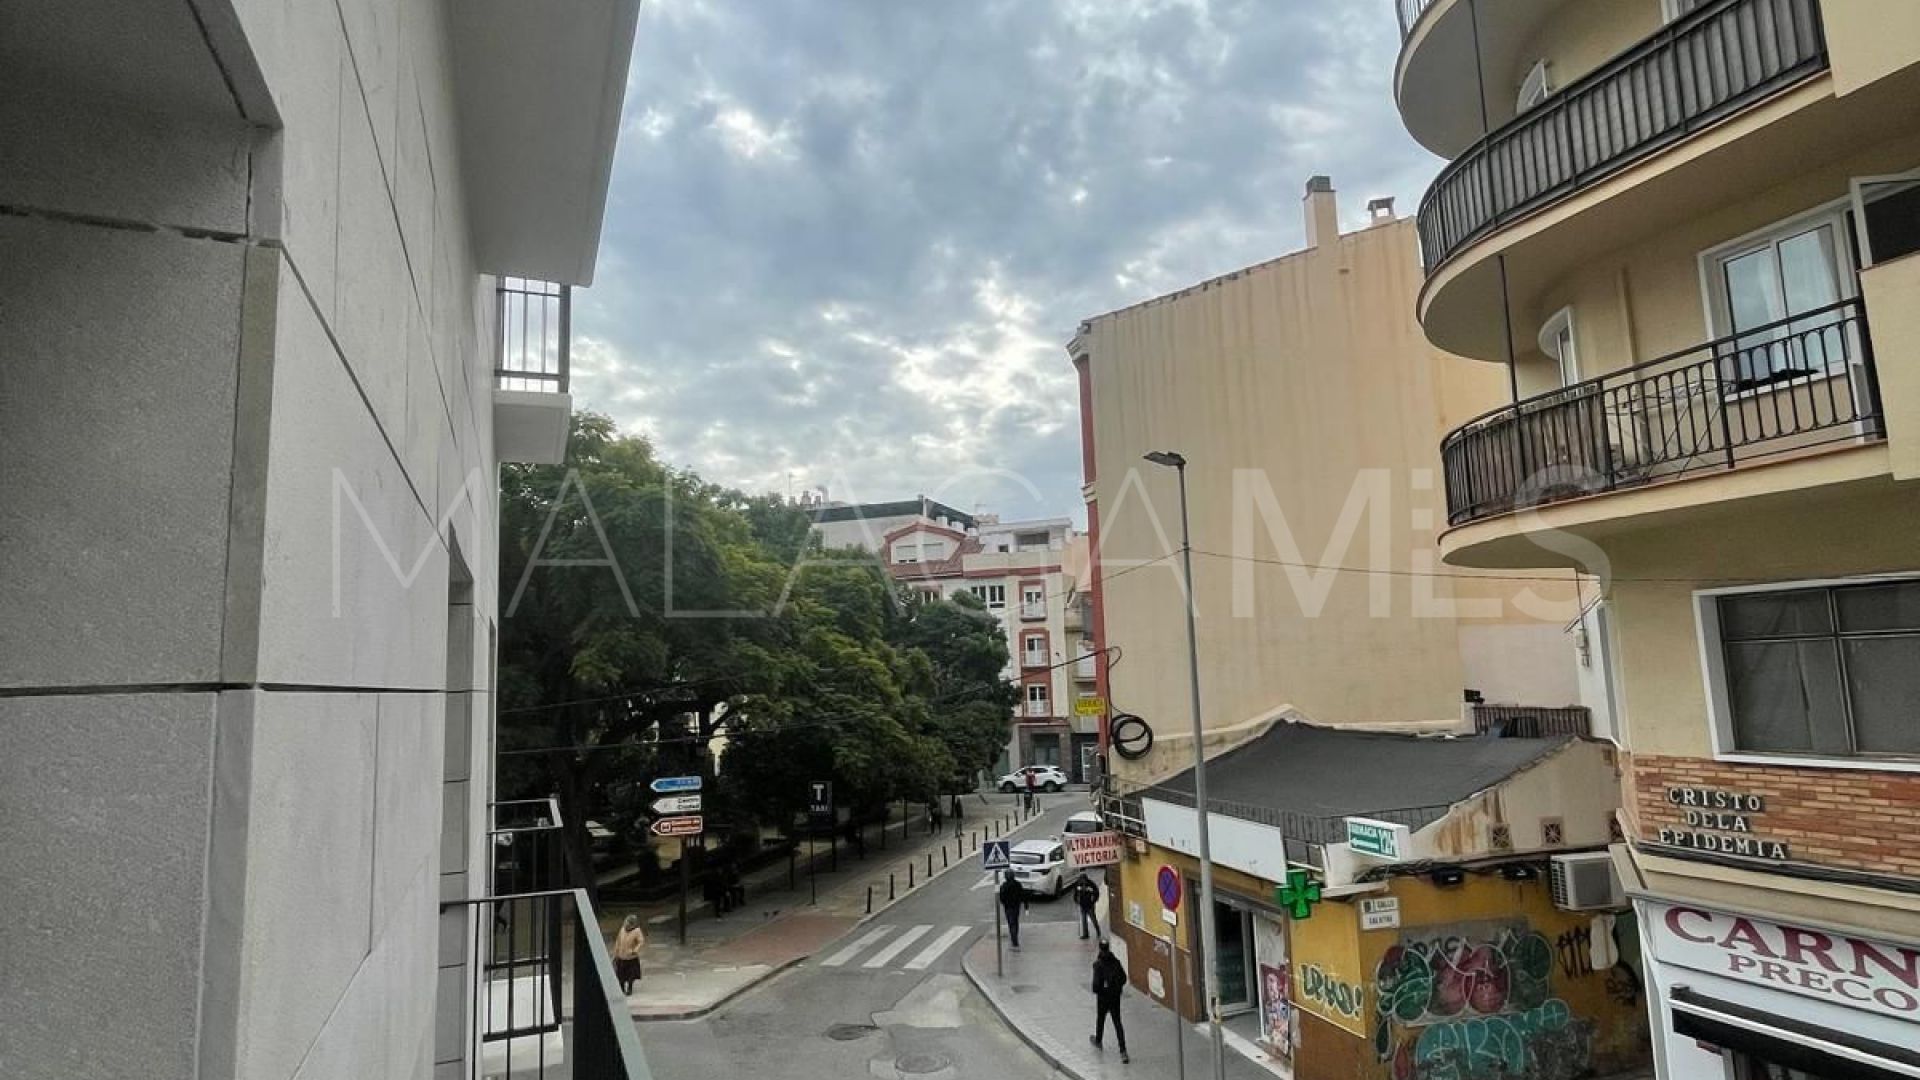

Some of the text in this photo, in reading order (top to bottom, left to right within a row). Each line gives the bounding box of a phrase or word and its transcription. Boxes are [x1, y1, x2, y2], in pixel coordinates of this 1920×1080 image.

[812, 783, 825, 801] T
[1668, 786, 1763, 811] CRISTO
[1073, 848, 1119, 865] VICTORIA
[1659, 829, 1786, 860] EPIDEMIA
[1664, 905, 1920, 990] CARN
[1728, 953, 1918, 1012] PRECO
